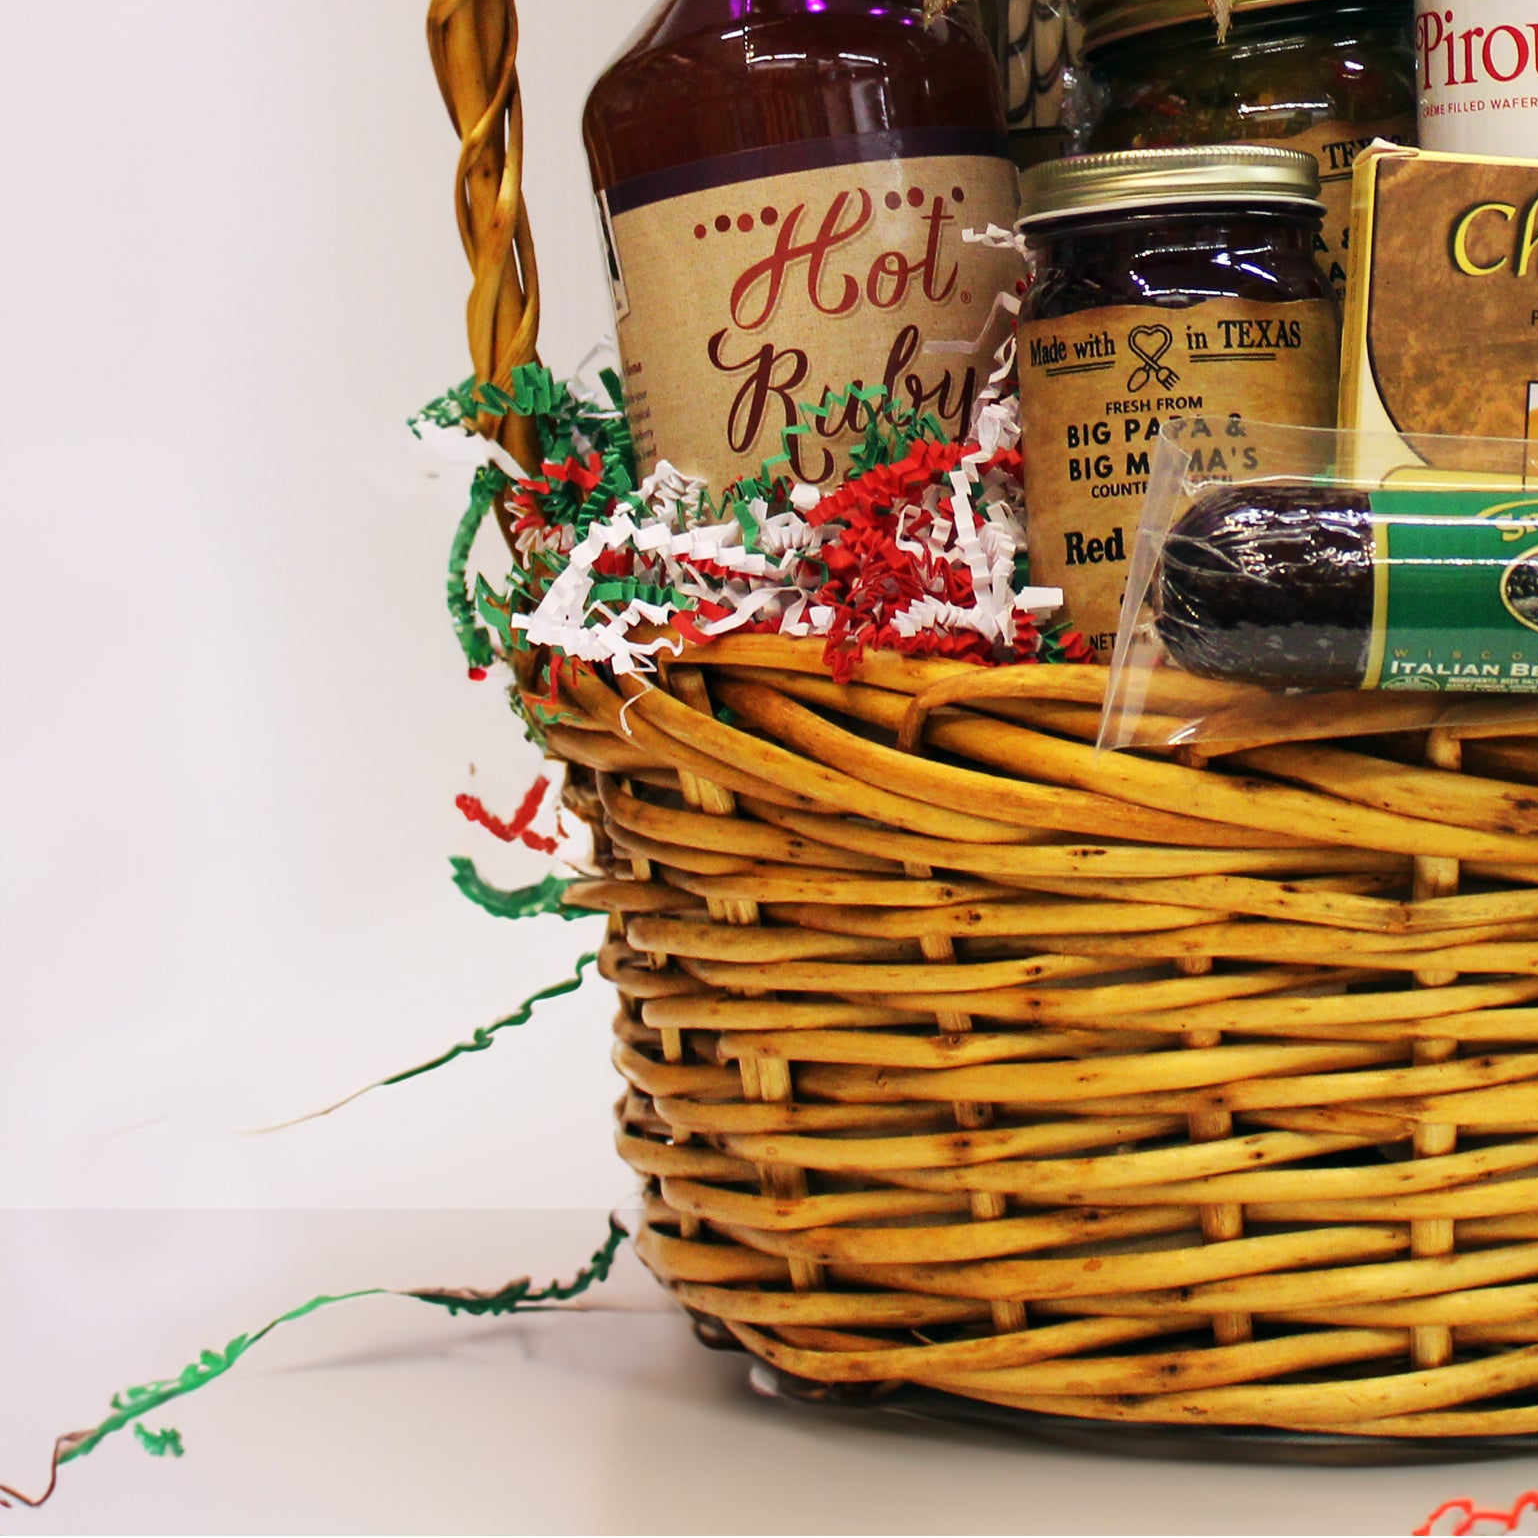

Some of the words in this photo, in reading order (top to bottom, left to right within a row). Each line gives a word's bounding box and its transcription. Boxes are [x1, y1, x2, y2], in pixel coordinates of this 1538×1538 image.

[1448, 100, 1486, 114] FILLED
[729, 187, 959, 331] Hot
[1029, 338, 1068, 367] Made
[1073, 330, 1117, 360] with
[1186, 325, 1208, 350] in
[1217, 320, 1301, 350] TEXAS
[1105, 398, 1152, 415] FRESH
[1156, 396, 1203, 412] FROM
[1066, 421, 1111, 449] BIG
[1225, 413, 1247, 438] &
[1069, 454, 1114, 482] BIG
[1064, 527, 1126, 566] Red
[1089, 634, 1116, 652] NET
[1390, 660, 1500, 676] ITALIAN
